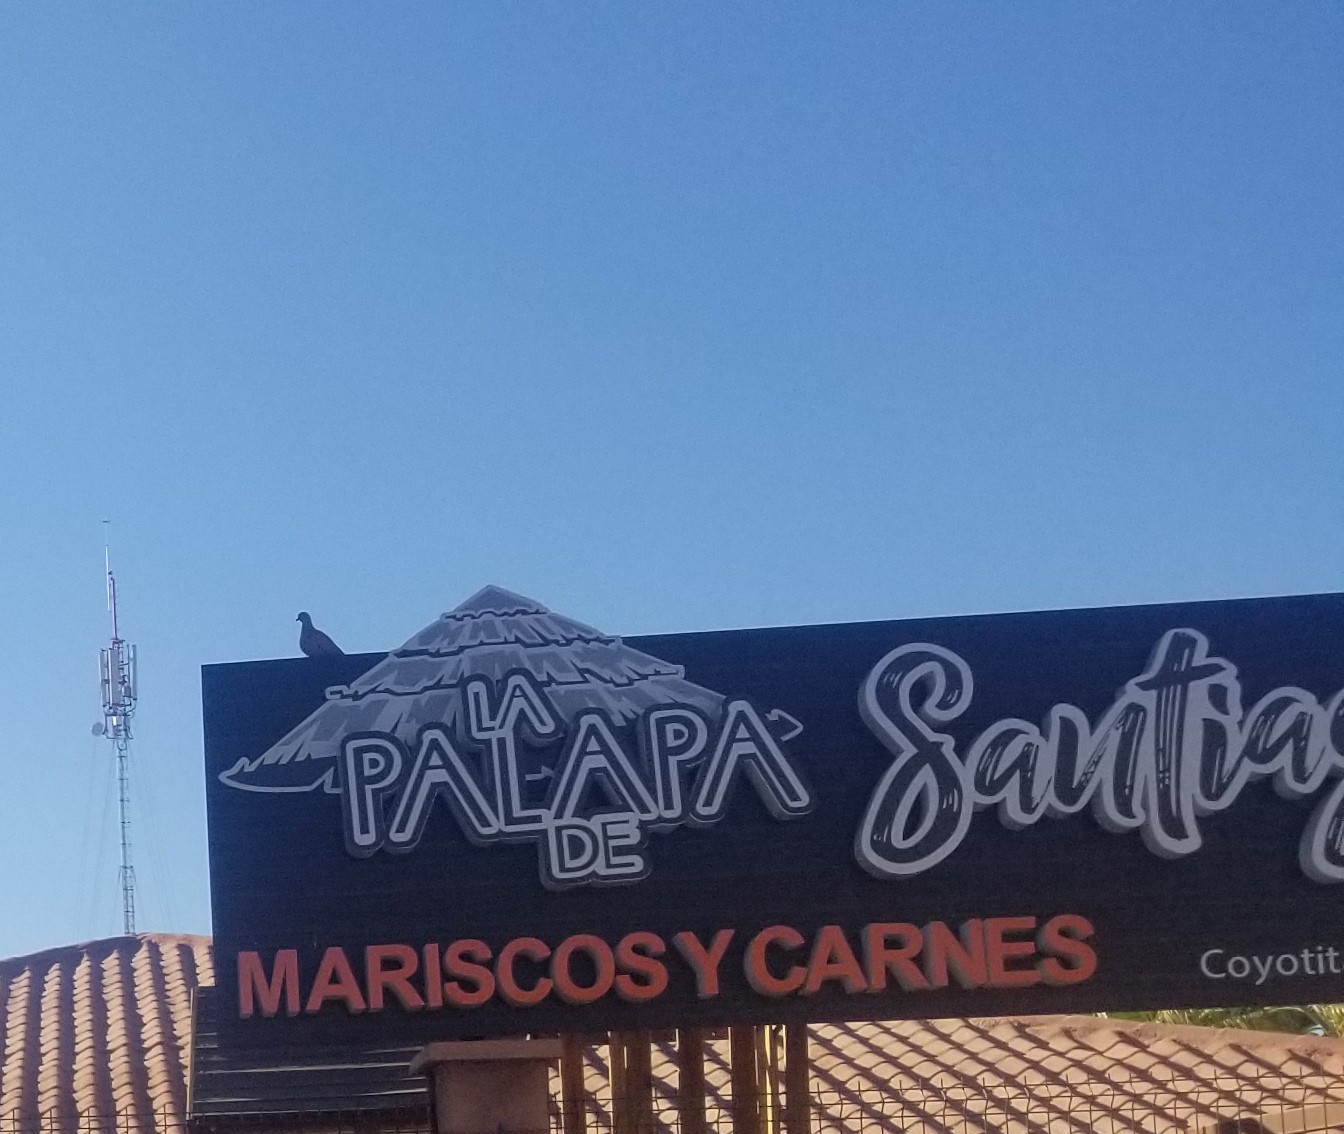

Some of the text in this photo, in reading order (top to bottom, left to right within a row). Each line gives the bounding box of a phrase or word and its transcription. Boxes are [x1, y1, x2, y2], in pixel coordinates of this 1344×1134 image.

[465, 674, 557, 738] LA
[855, 627, 1344, 884] Santia
[340, 698, 810, 846] PALAPA
[549, 811, 645, 879] DE
[236, 914, 1099, 1018] MARISCOS Y CARNES
